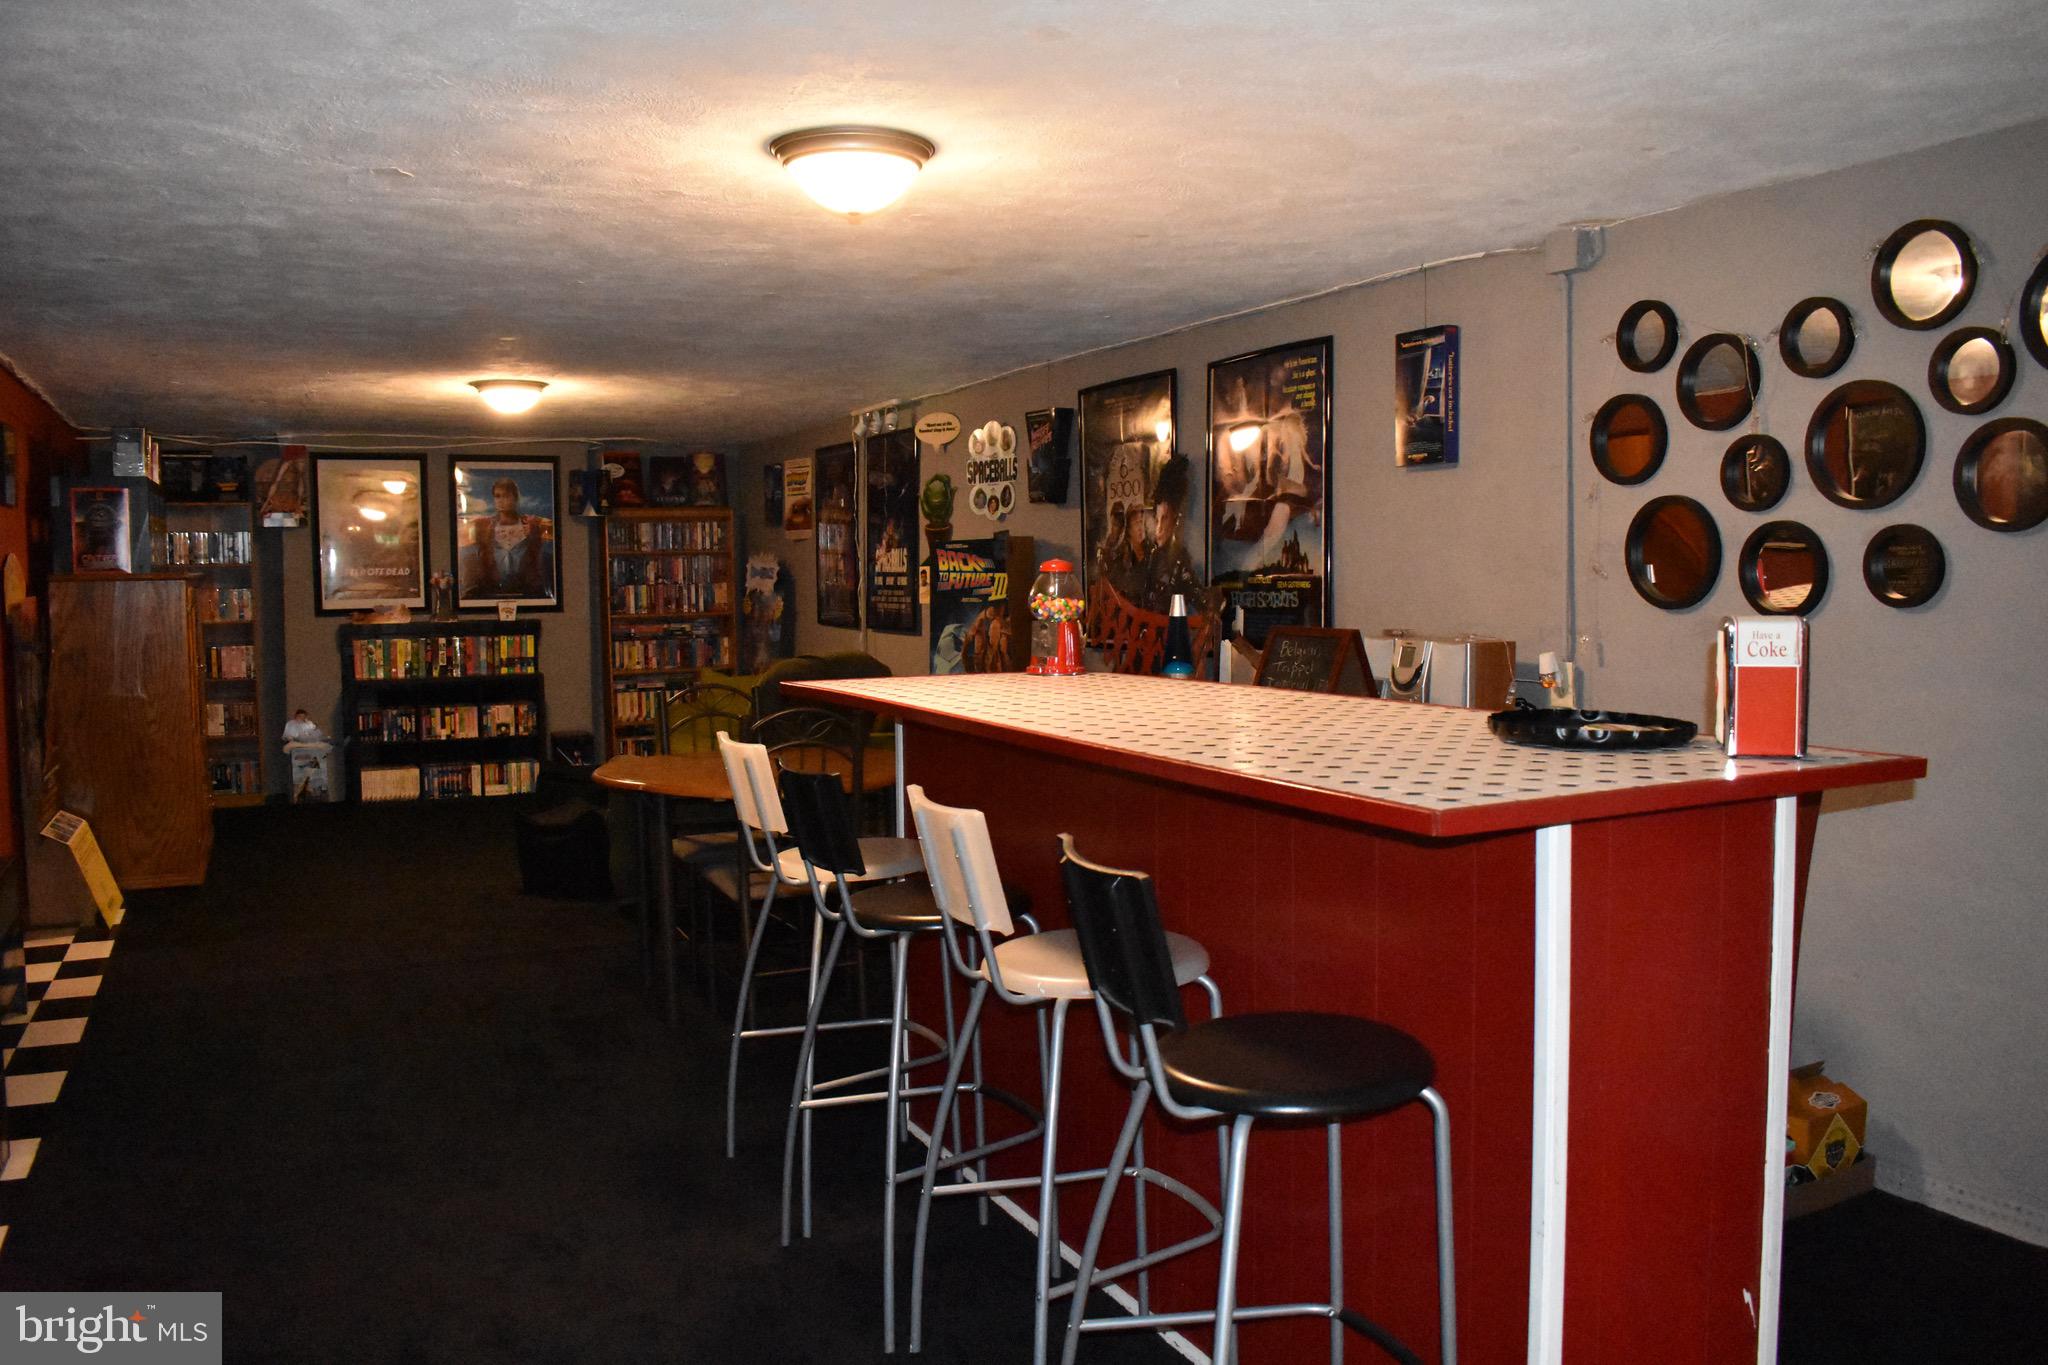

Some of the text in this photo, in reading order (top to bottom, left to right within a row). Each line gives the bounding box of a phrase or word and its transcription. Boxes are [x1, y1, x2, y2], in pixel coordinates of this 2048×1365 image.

[967, 457, 1018, 485] SPACEBALLS
[936, 549, 985, 572] BACK
[386, 567, 411, 577] DEAD
[948, 572, 994, 590] FUTURE
[1752, 630, 1774, 640] Have
[1747, 640, 1788, 657] Coke
